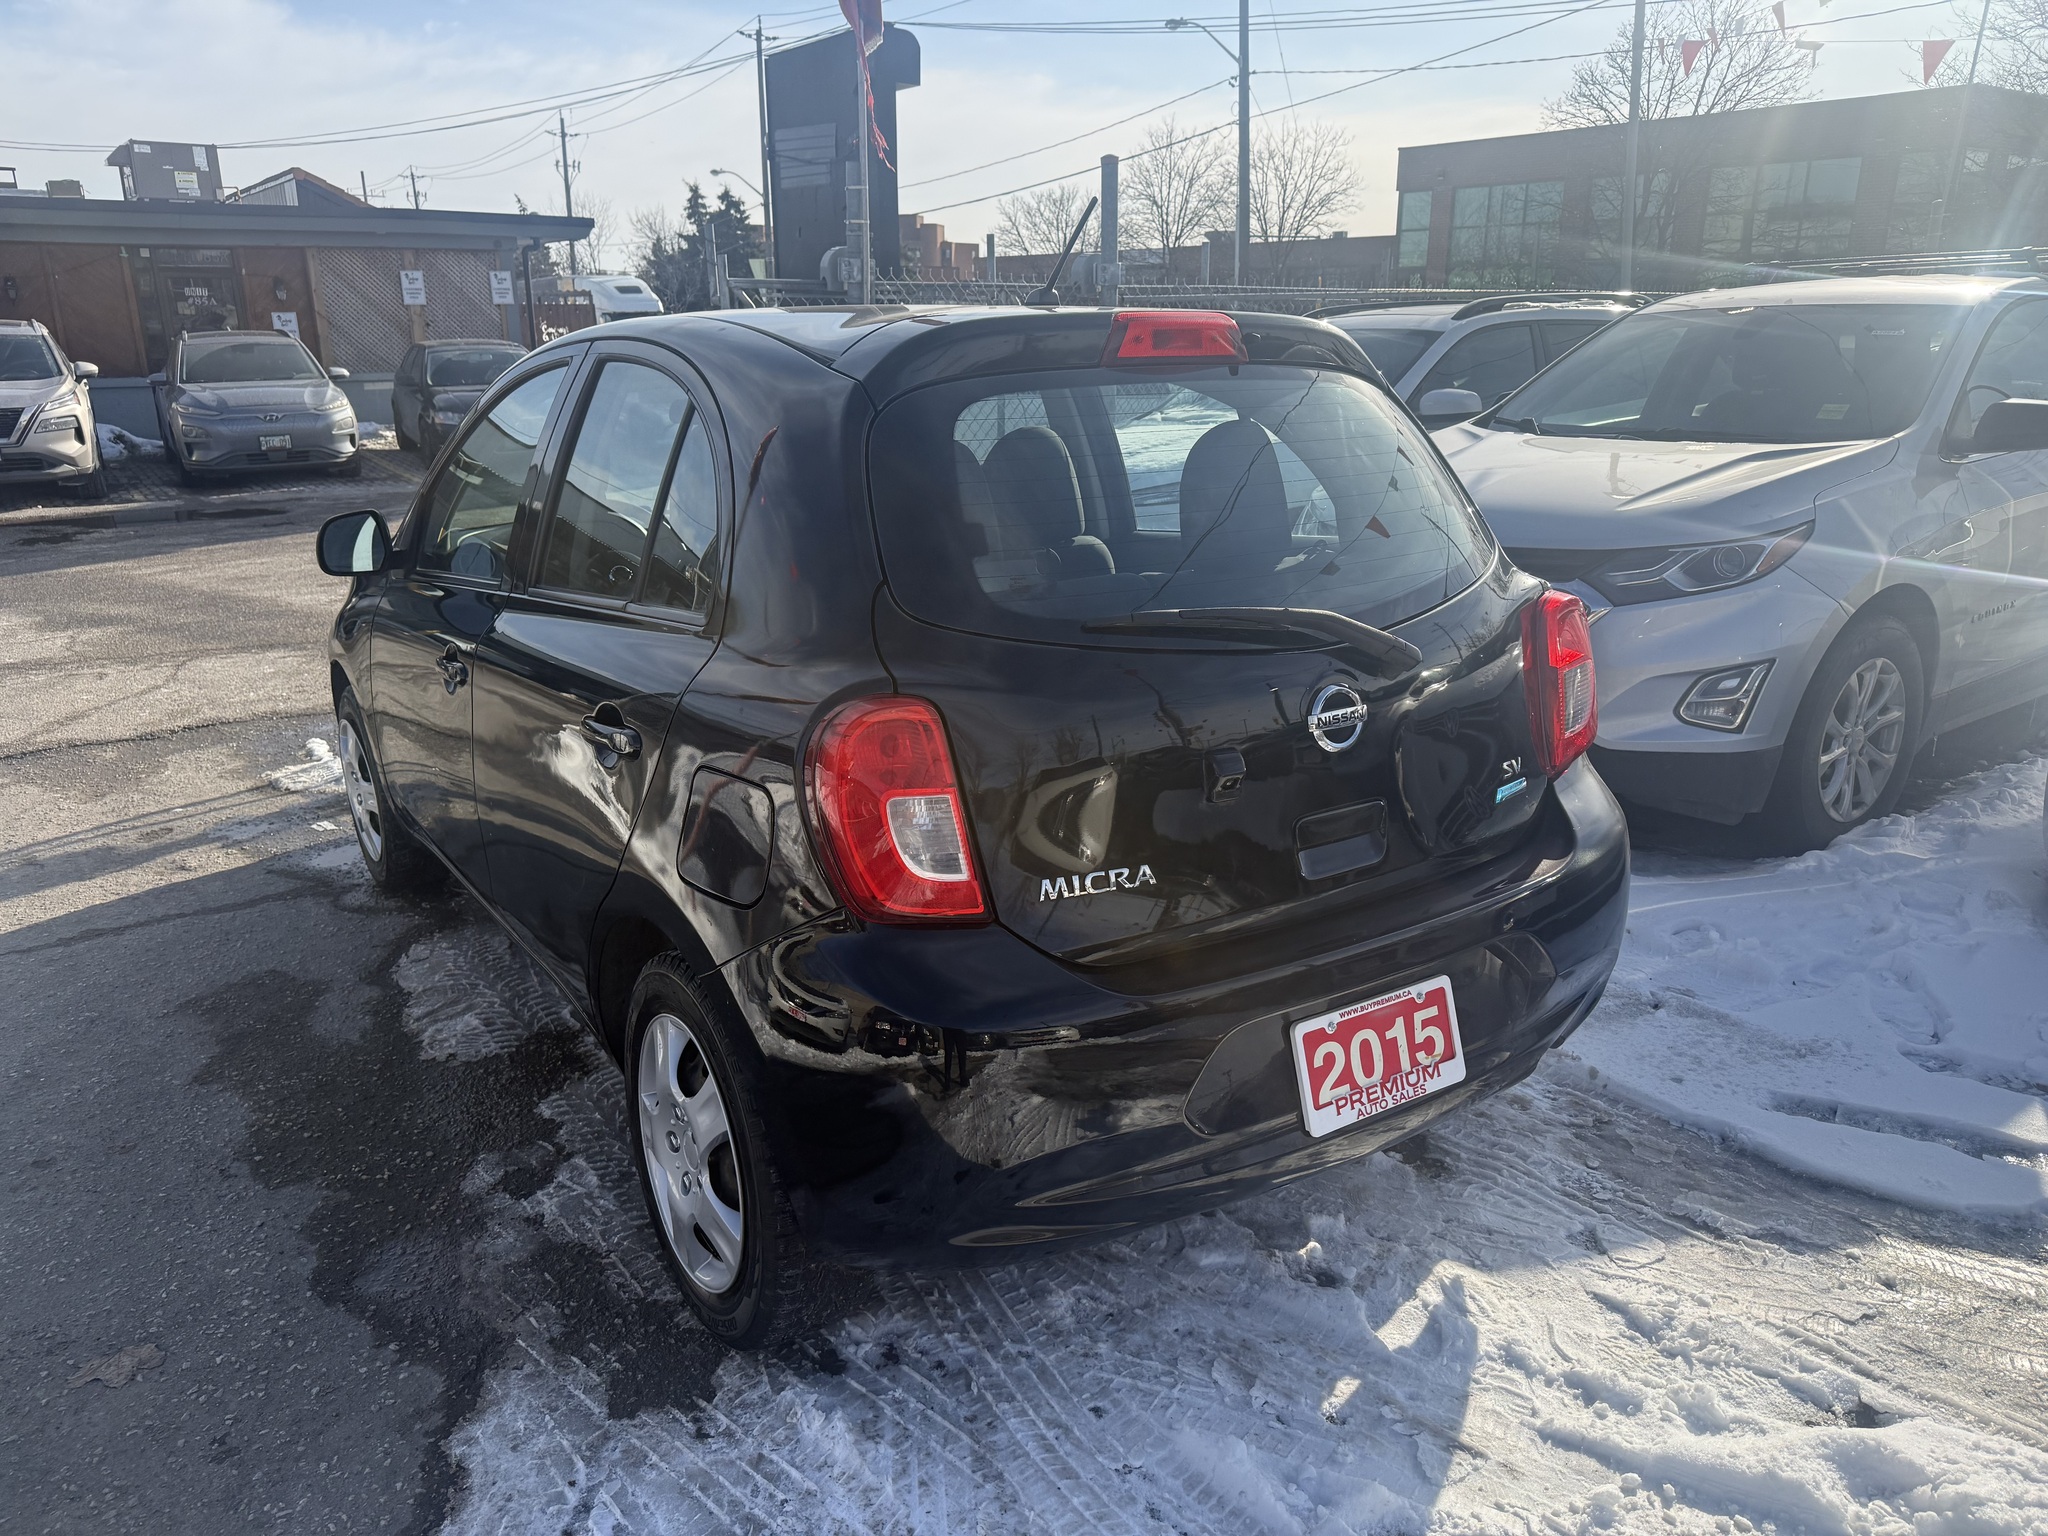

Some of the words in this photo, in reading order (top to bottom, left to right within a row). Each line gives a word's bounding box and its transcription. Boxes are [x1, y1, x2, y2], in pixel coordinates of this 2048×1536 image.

[1316, 706, 1365, 727] NISSAN
[1502, 756, 1521, 778] SV
[1040, 864, 1157, 902] MICRA
[1338, 989, 1413, 1019] WWW.BUYPREMIUM.CA
[1313, 1005, 1445, 1106] 2015
[1334, 1061, 1442, 1116] PREMIUM
[1357, 1099, 1388, 1119] AUTO
[1391, 1084, 1427, 1105] SALES
